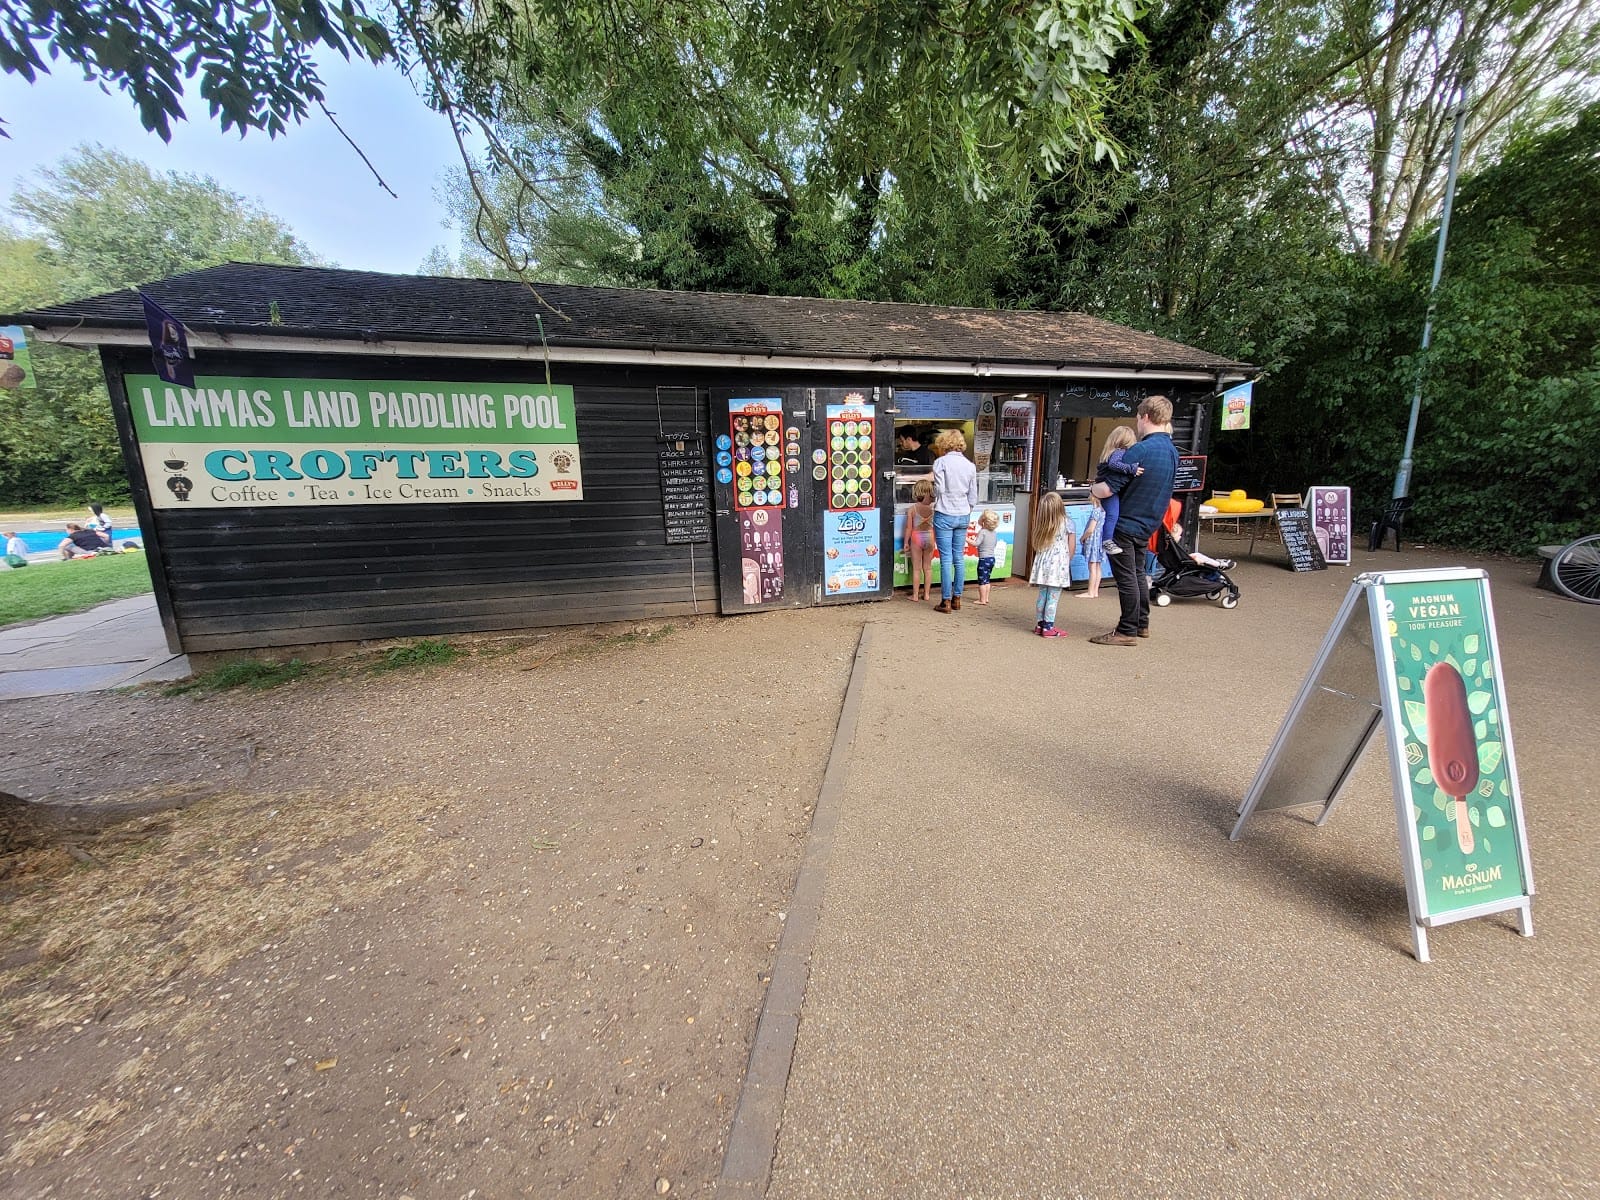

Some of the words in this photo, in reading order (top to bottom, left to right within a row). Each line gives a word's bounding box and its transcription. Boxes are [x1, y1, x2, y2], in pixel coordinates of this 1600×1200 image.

[142, 387, 276, 428] LAMMAS
[283, 390, 361, 428] LAND
[368, 391, 497, 429] PADDLING
[503, 394, 567, 429] POOL
[204, 449, 539, 482] CROFTERS
[211, 485, 278, 502] Coffee
[304, 484, 340, 501] Tea
[364, 484, 393, 500] Ice
[399, 483, 460, 499] Cream
[482, 482, 541, 498] Snacks
[551, 480, 576, 488] KELLY'S
[1411, 594, 1455, 605] MAGNUM
[1408, 603, 1460, 619] VEGAN
[1408, 623, 1426, 631] 100%
[1428, 619, 1465, 629] PLEASURE
[1442, 864, 1503, 891] MAGNUM
